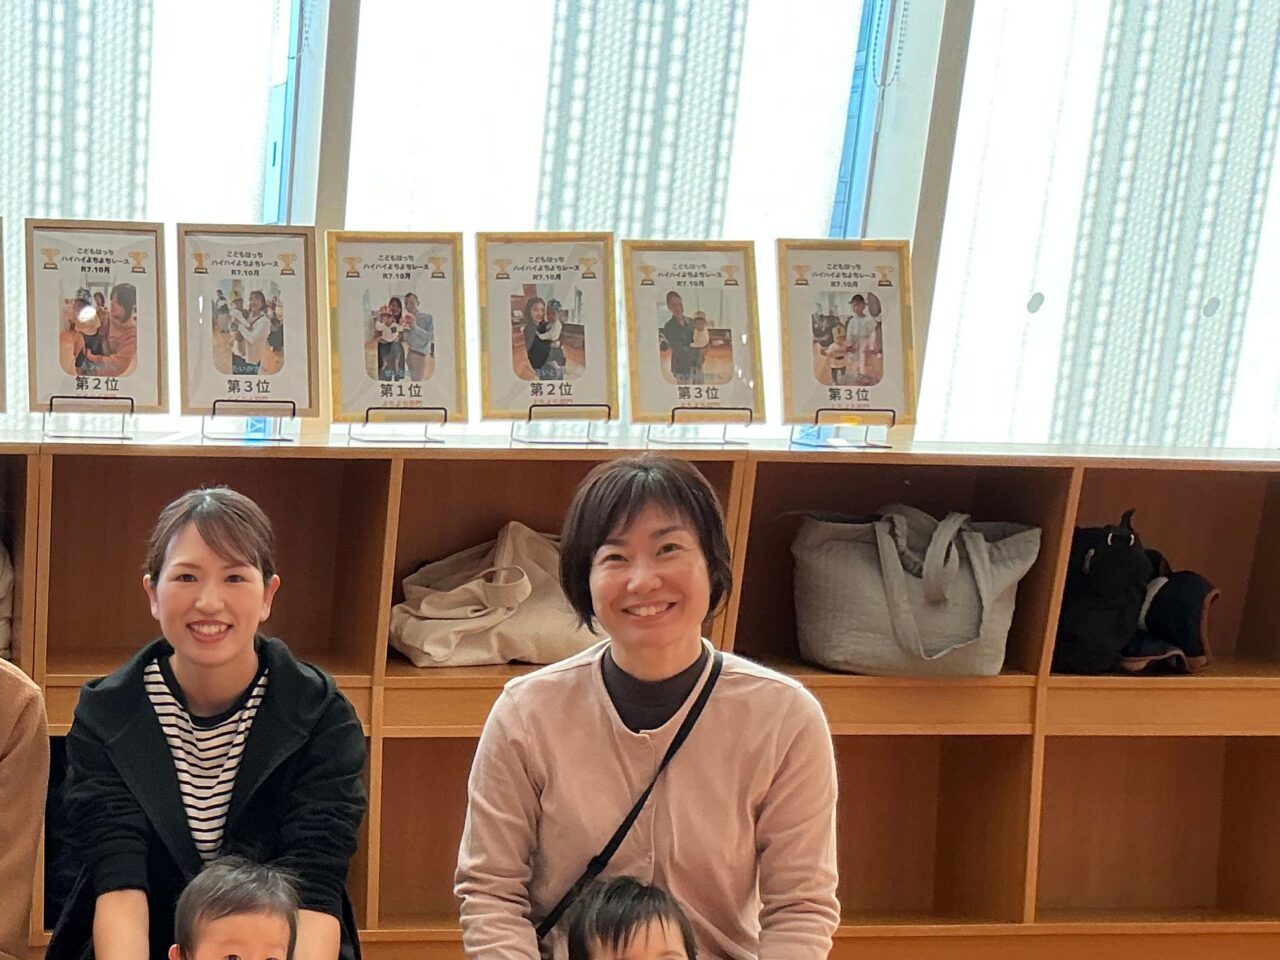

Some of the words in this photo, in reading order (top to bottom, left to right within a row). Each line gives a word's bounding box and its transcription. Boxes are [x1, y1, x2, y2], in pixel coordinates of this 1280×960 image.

[211, 259, 280, 268] ハイハイよちよちレース
[75, 375, 120, 392] 第2位
[227, 379, 271, 394] 第3位
[380, 383, 423, 398] 第1位
[530, 382, 573, 397] 第2位
[677, 385, 720, 400] 第3位
[828, 387, 870, 402] 第3位
